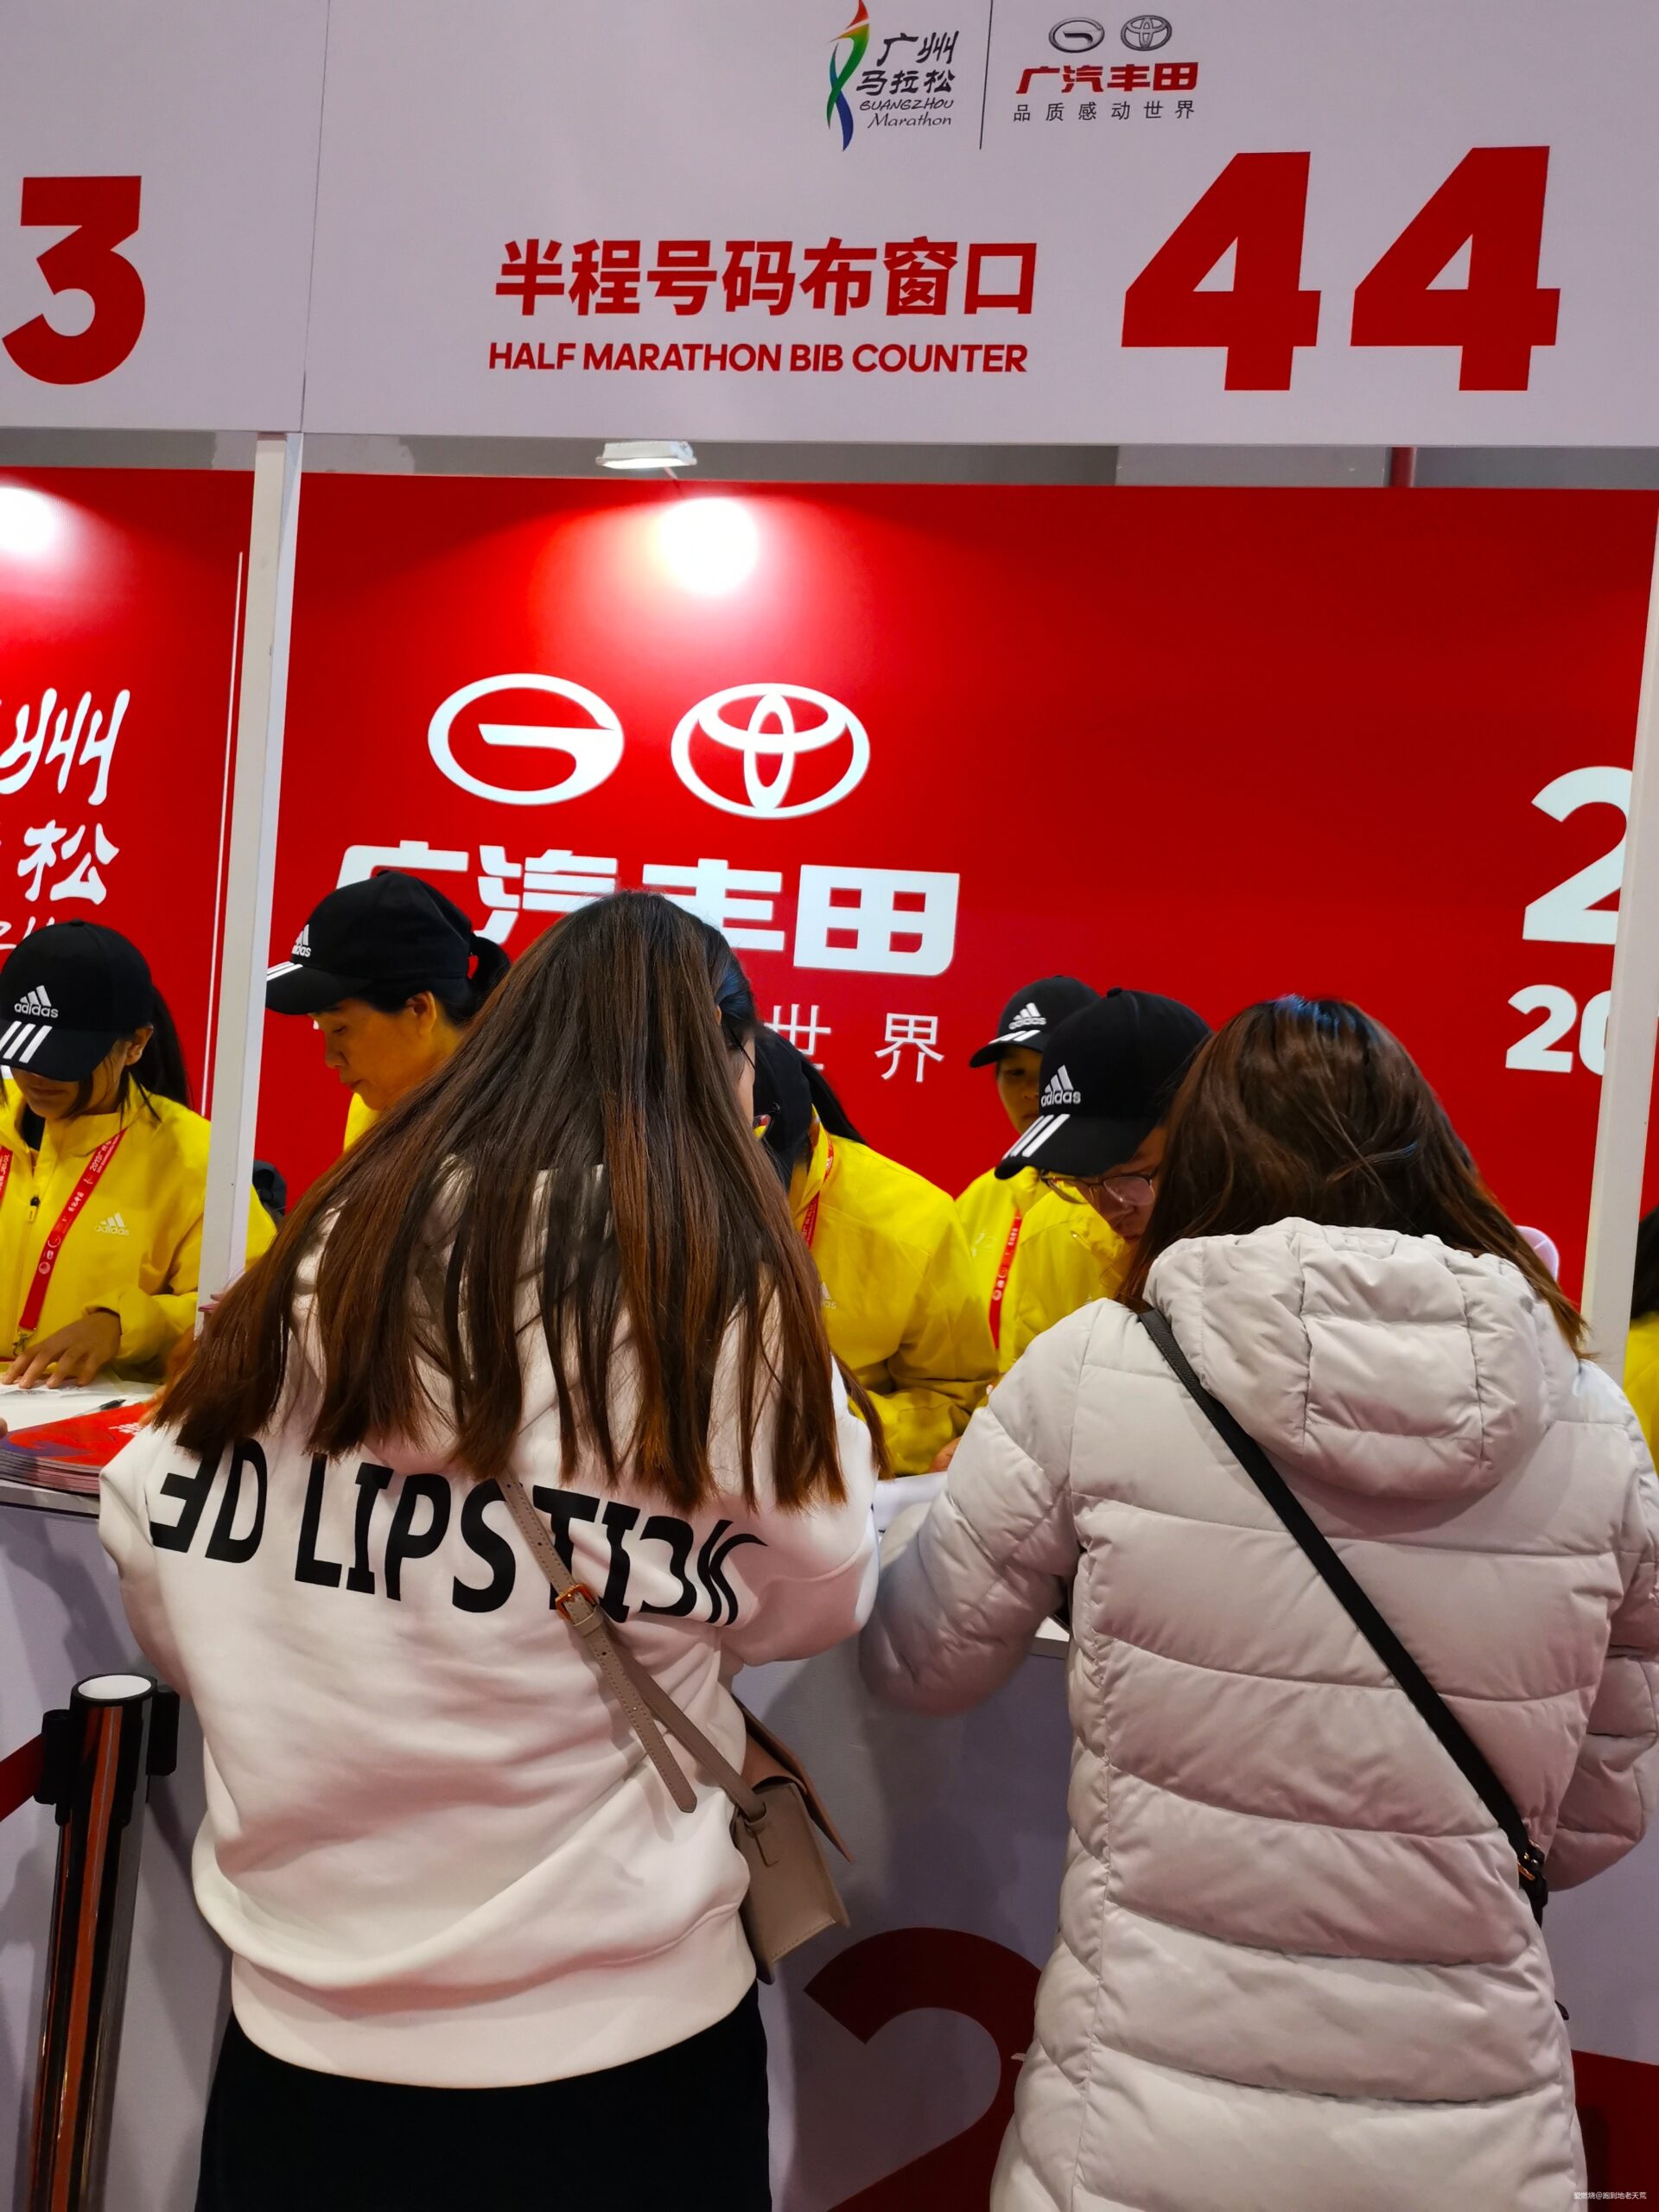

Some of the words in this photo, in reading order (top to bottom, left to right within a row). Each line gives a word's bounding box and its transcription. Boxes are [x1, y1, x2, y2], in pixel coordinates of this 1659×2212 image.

[875, 30, 960, 67] 广州
[855, 69, 957, 97] 马拉松
[1014, 61, 1199, 95] 广汽丰田
[859, 98, 955, 111] GUANGZHOU
[1013, 100, 1195, 123] 品质感动世界
[867, 111, 952, 130] Marathon
[495, 236, 1038, 316] 半程号码布窗口
[1121, 145, 1561, 391] 44
[488, 342, 576, 370] HALF
[582, 342, 781, 372] MARATHON
[790, 343, 845, 372] BIB
[852, 343, 1028, 372] COUNTER
[14, 1001, 60, 1020] adidas
[1040, 1090, 1082, 1107] adidas
[94, 1225, 130, 1236] adidas
